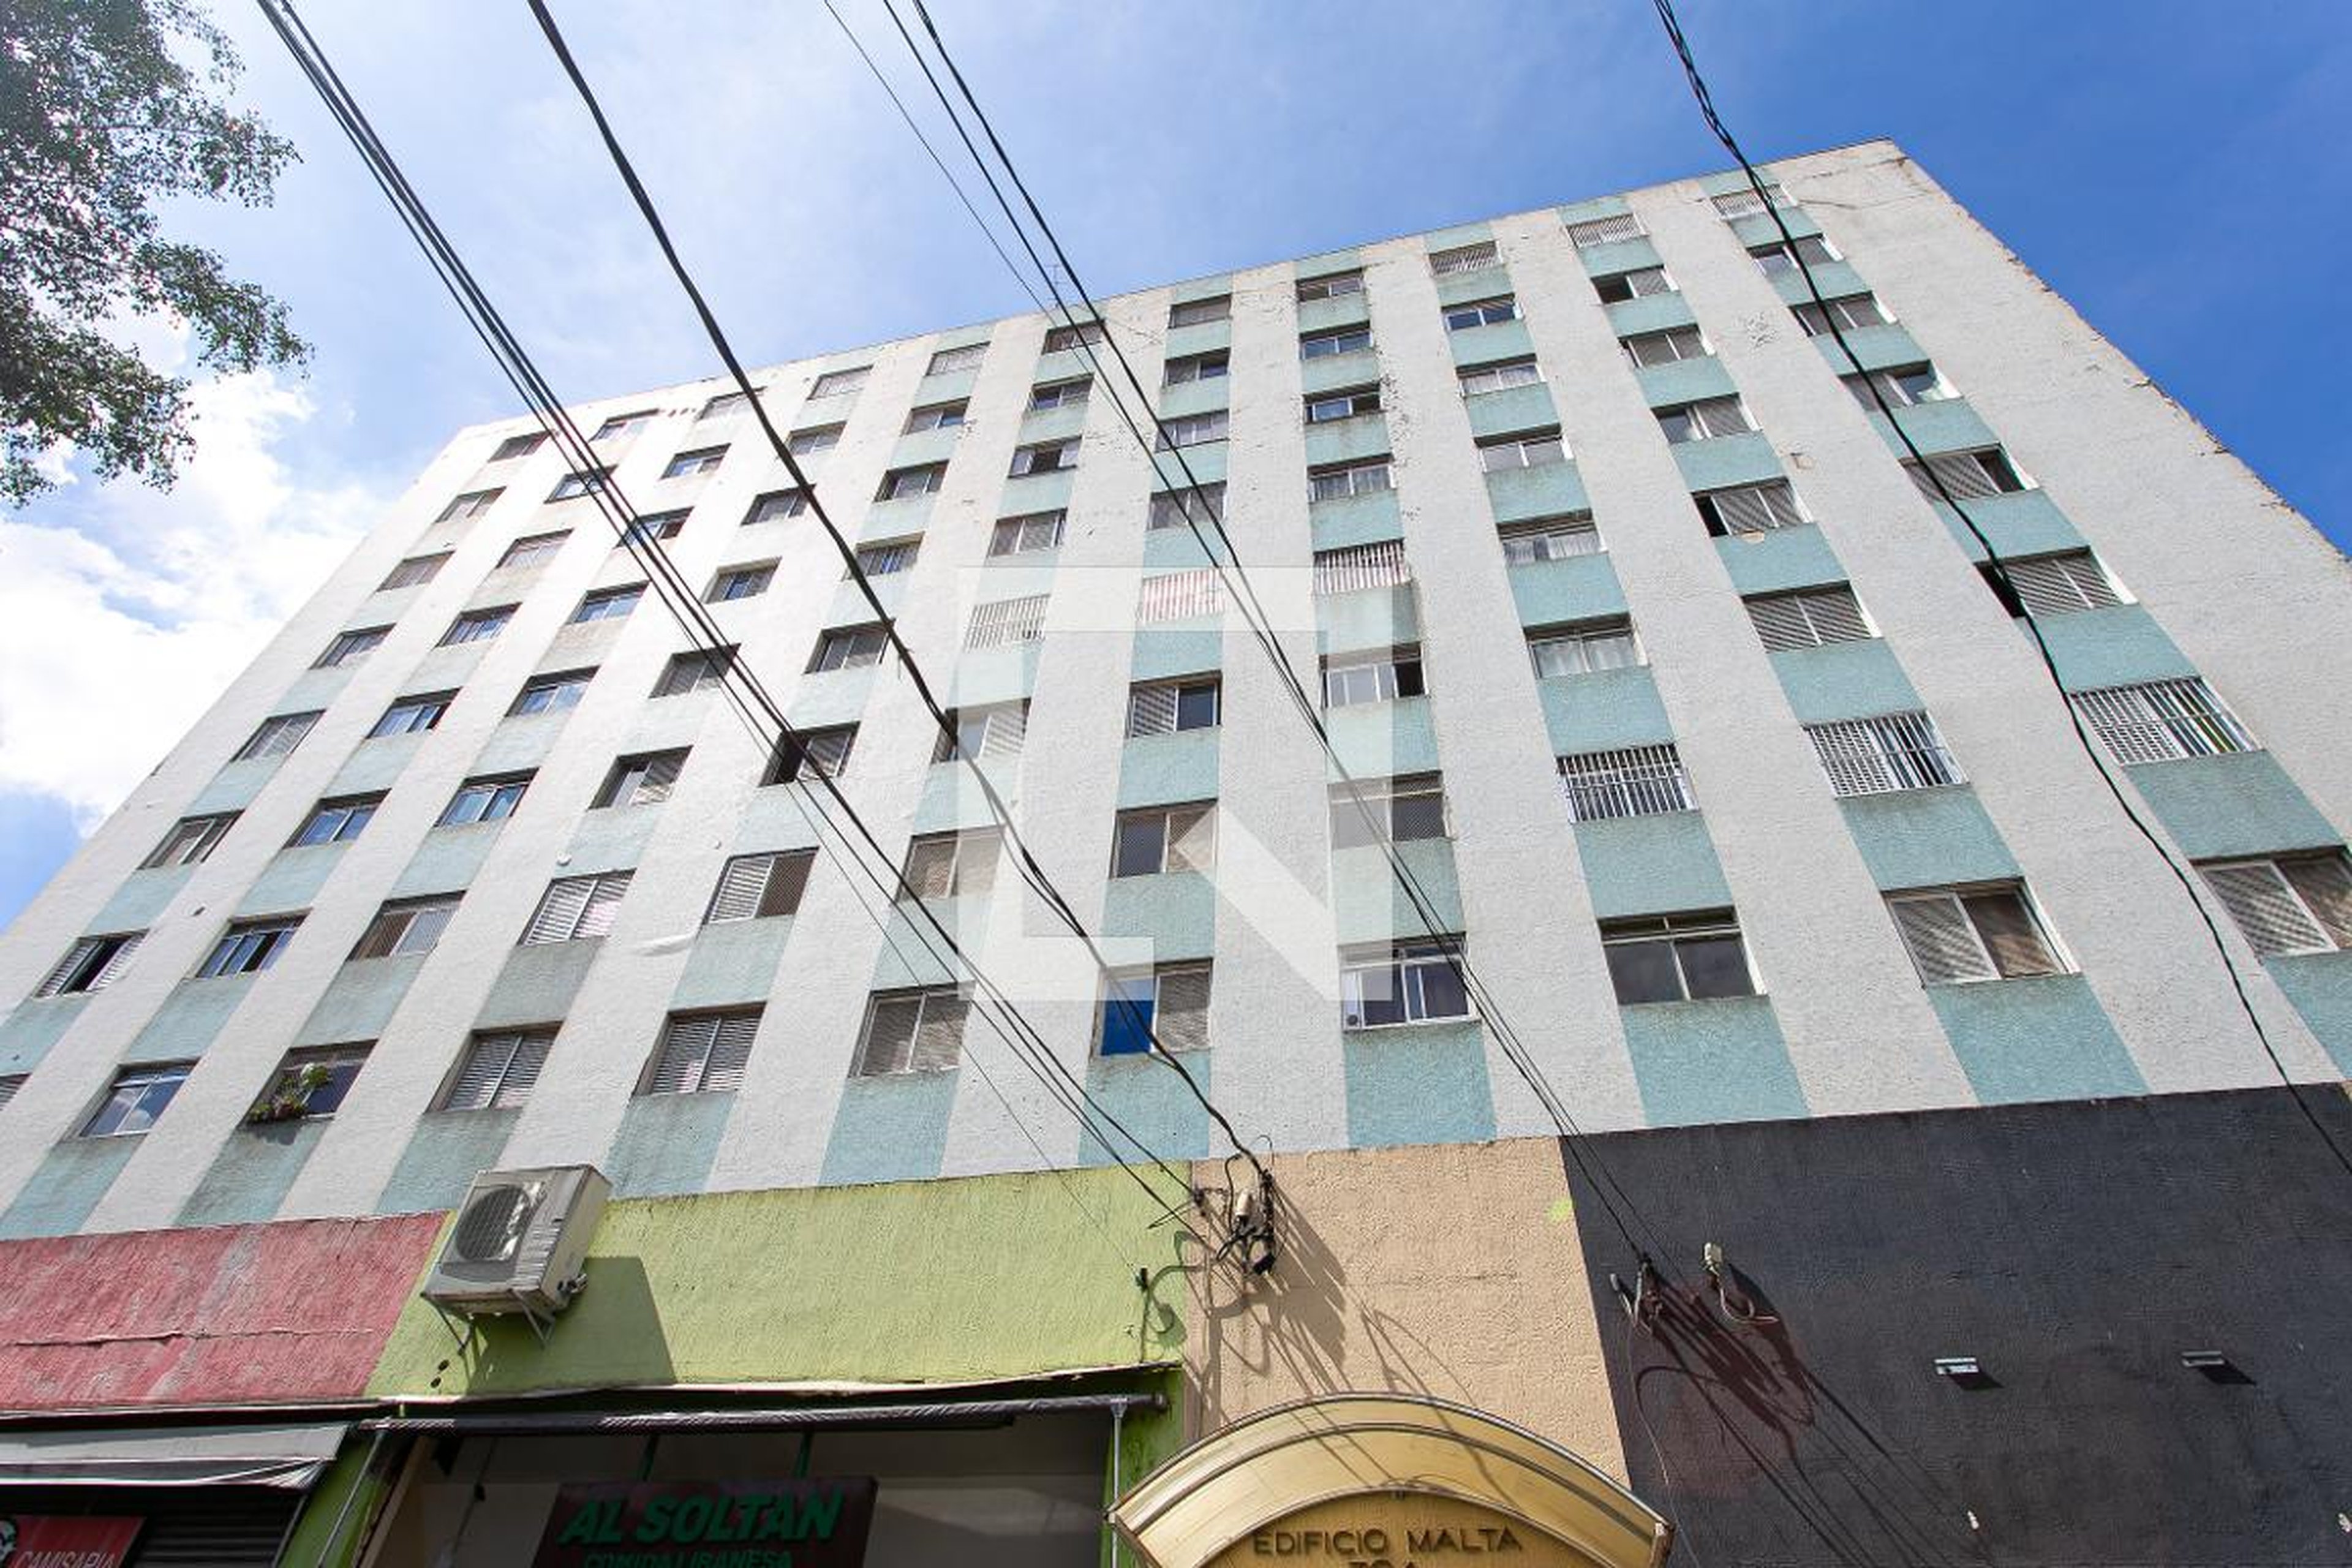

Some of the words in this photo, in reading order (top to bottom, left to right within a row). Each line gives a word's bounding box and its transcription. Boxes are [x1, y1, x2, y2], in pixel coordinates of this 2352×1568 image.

[556, 1496, 627, 1545] AL
[635, 1487, 845, 1544] SOLTAN
[1253, 1528, 1388, 1556] EDIFICIO
[1406, 1526, 1523, 1553] MALTA
